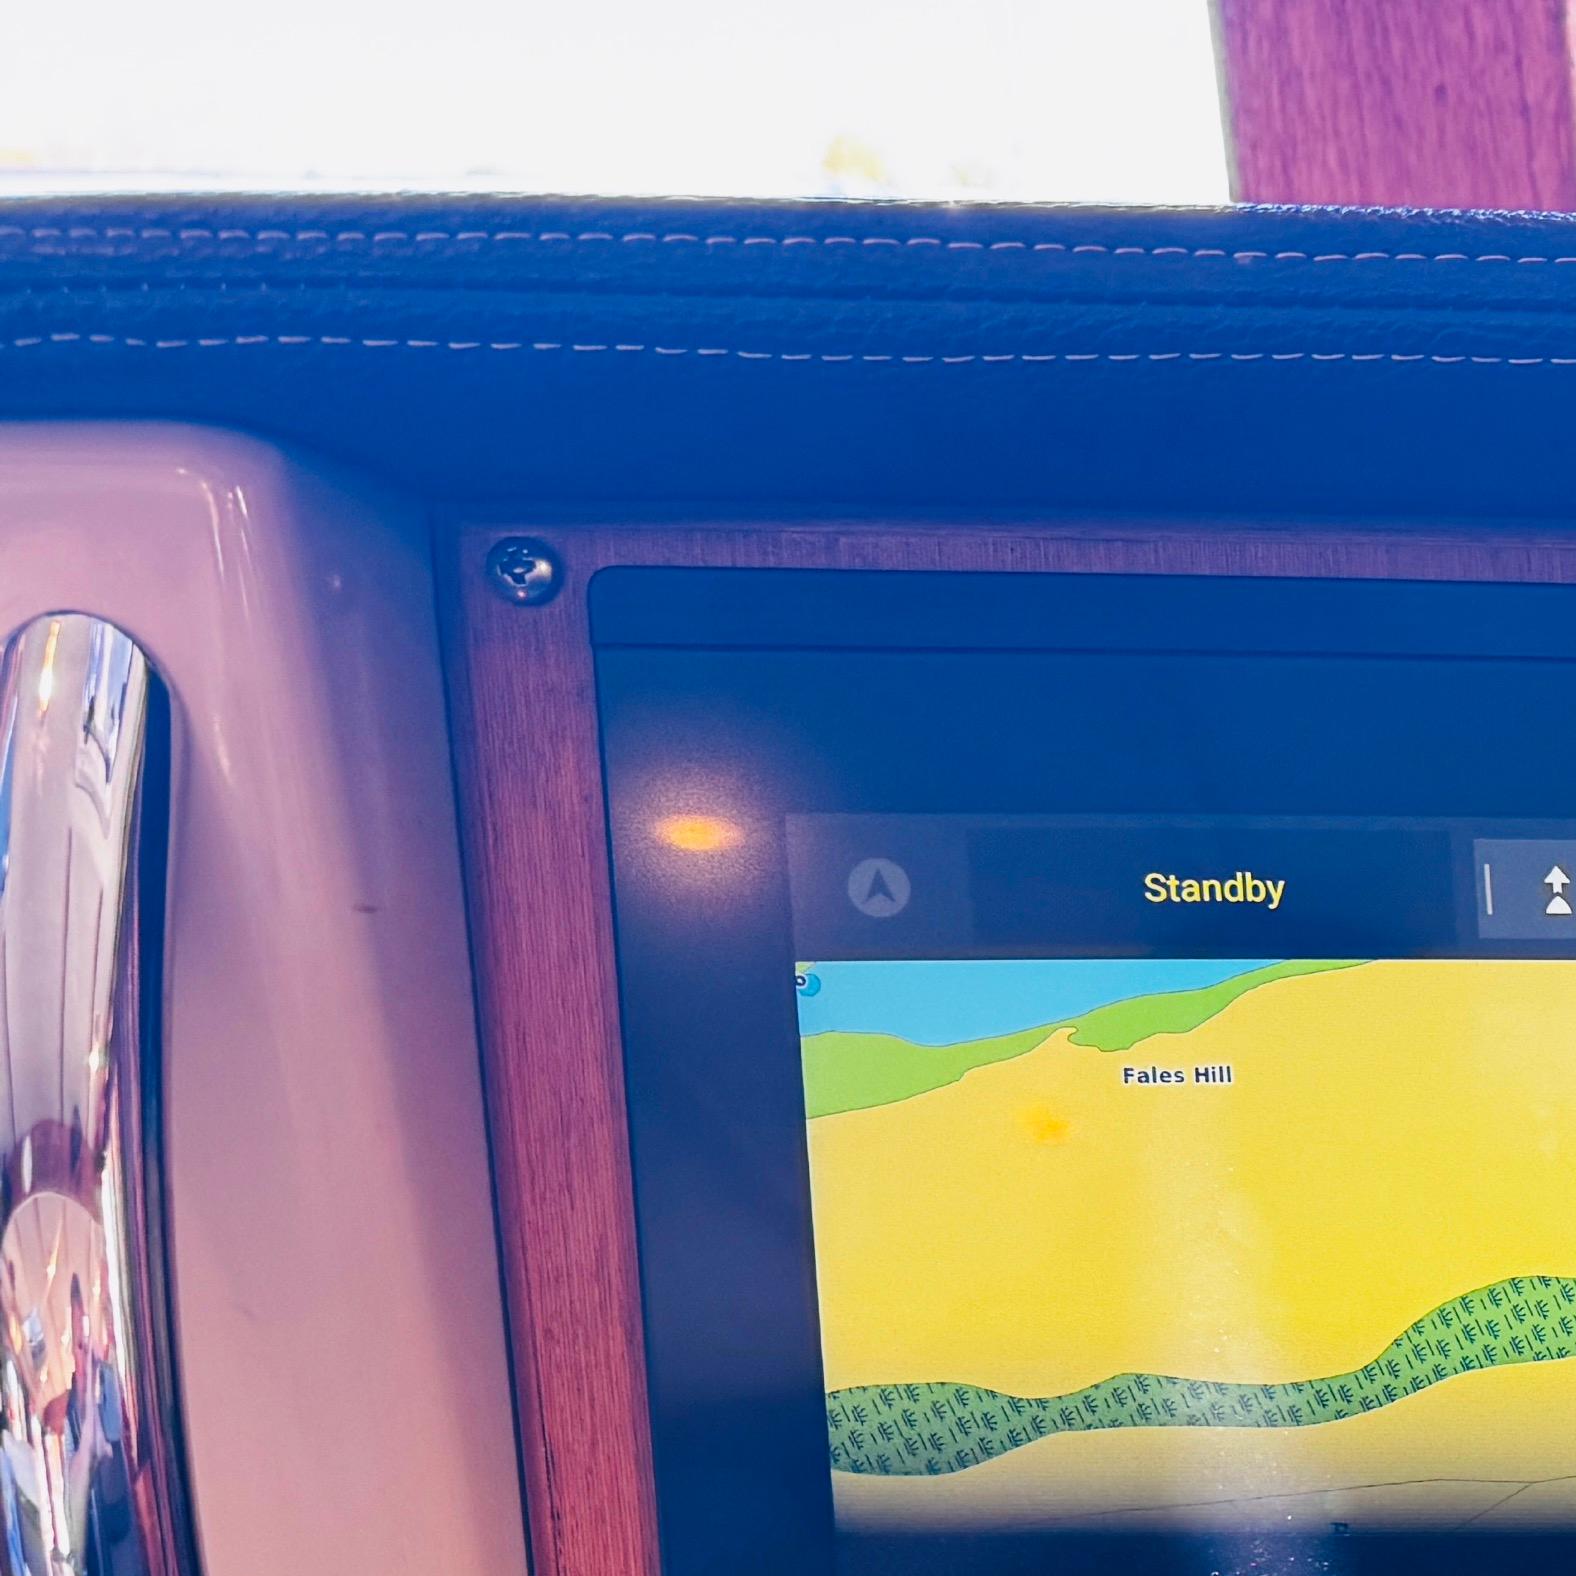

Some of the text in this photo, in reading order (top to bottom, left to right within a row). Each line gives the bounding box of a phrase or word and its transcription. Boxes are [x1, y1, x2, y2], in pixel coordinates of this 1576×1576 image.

[1144, 871, 1286, 910] Standby
[1122, 1065, 1233, 1085] Fales Hill
